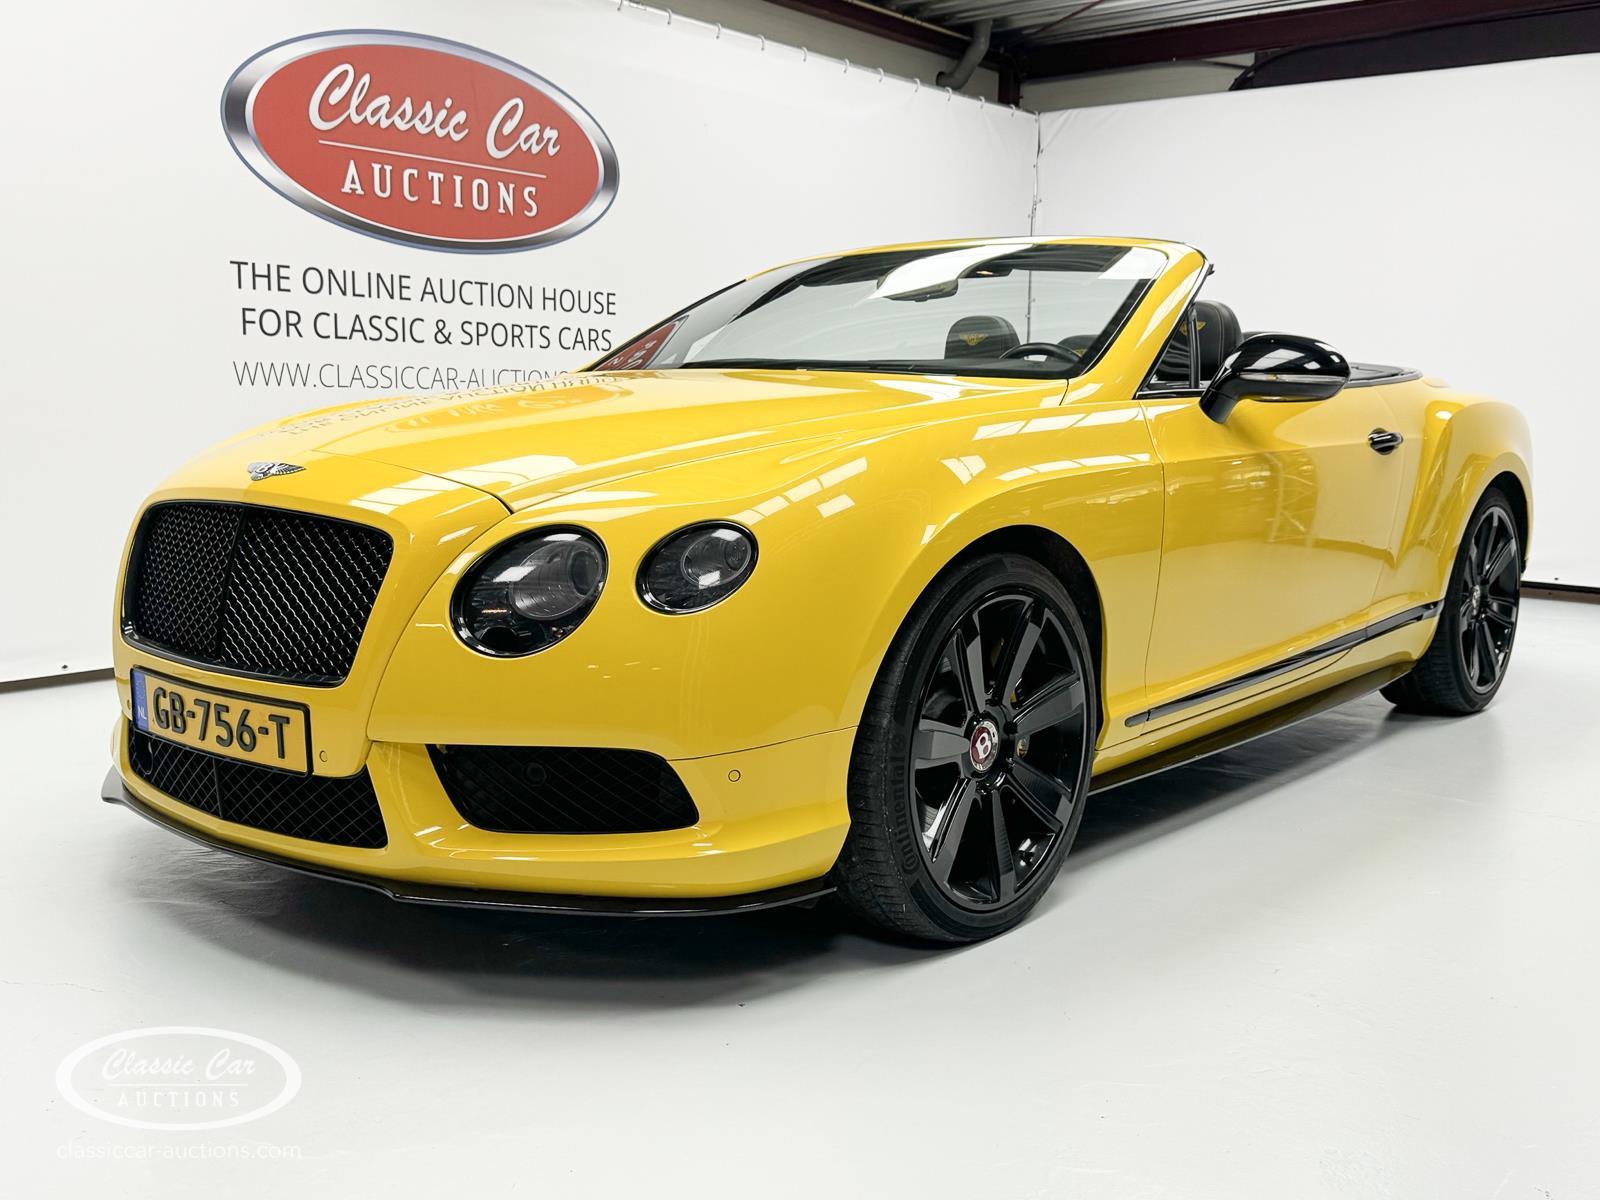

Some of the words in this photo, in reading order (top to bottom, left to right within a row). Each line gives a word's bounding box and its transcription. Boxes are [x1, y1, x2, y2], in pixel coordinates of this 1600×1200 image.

[308, 63, 469, 142] Classic
[486, 97, 560, 159] Car
[341, 159, 539, 218] AUCTIONS
[229, 260, 291, 293] THE
[302, 266, 412, 301] ONLINE
[420, 276, 533, 310] AUCTION
[542, 286, 616, 315] HOUSE
[242, 307, 303, 338] FOR
[313, 311, 425, 343] CLASSIC
[434, 318, 453, 345] &
[460, 320, 551, 349] SPORTS
[558, 326, 612, 351] CARS
[137, 706, 147, 721] NL
[152, 687, 290, 760] GB-756-T
